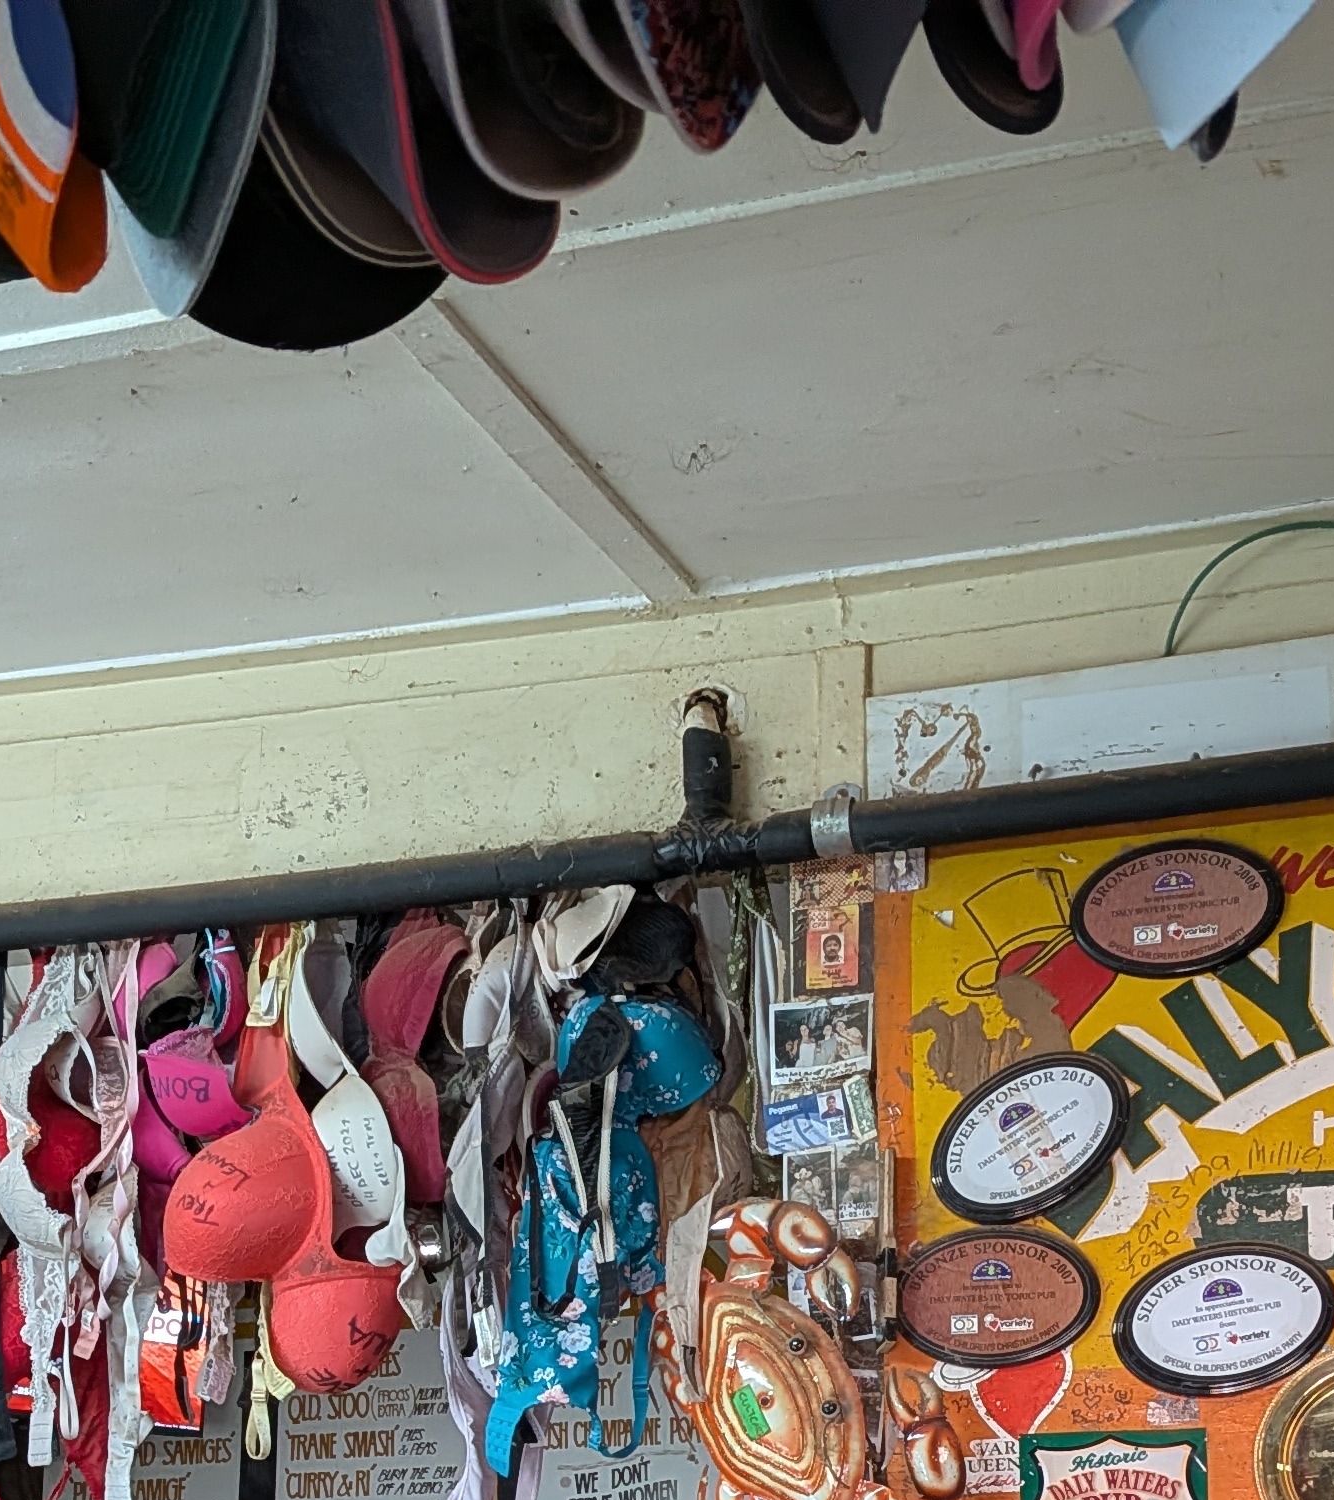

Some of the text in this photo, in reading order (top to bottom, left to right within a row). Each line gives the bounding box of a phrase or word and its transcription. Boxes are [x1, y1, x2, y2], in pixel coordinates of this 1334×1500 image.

[950, 1070, 1095, 1174] SILVER SPONSOR 2013
[1137, 1258, 1314, 1323] SILVER SPONSOR 2014
[574, 1456, 651, 1494] WE DON'T
[1068, 1447, 1148, 1473] Historic
[1103, 1469, 1183, 1500] WATERS
